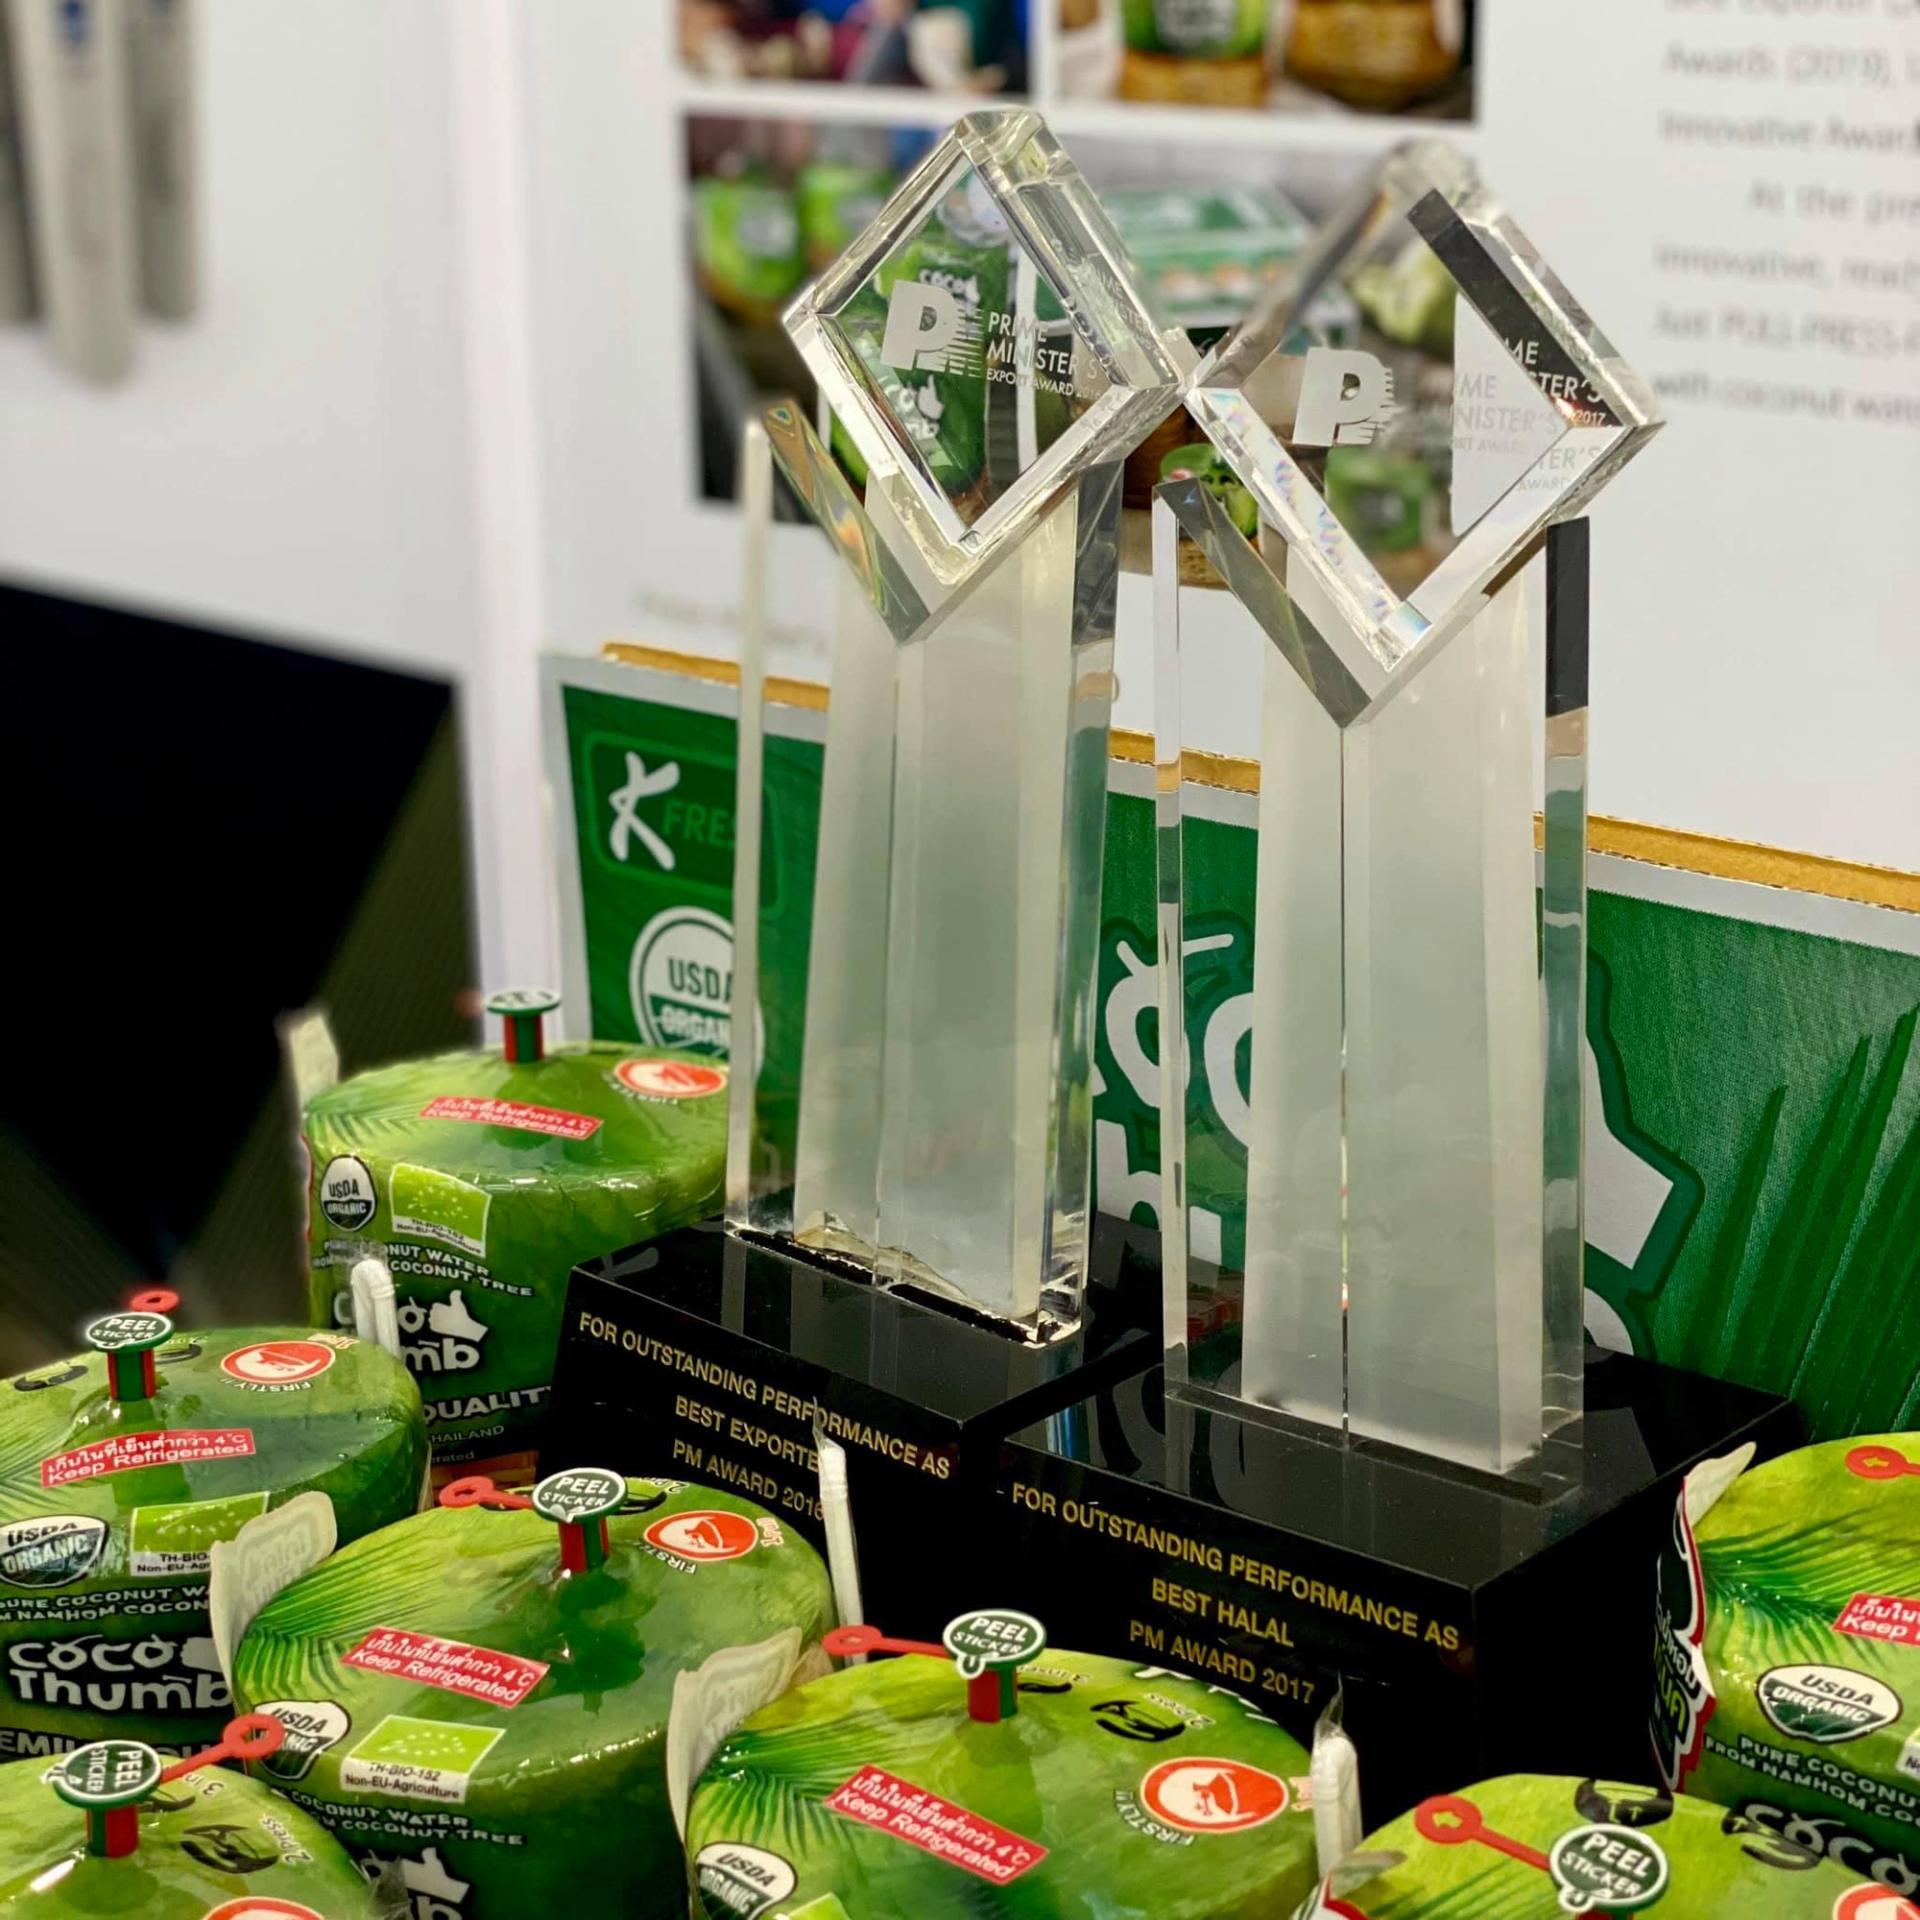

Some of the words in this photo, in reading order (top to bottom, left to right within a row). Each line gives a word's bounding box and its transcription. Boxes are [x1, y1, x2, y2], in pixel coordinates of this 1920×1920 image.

[987, 311, 1047, 343] PRIME
[1033, 377, 1075, 397] AWARD
[662, 800, 736, 848] FRE
[328, 1179, 360, 1199] USDA
[326, 1200, 368, 1216] ORGANIC
[390, 1260, 477, 1283] COCONUT
[479, 1276, 534, 1297] TREE
[426, 1247, 490, 1277] WATER
[92, 1329, 155, 1340] STICKER
[105, 1317, 157, 1332] PEEL
[423, 1386, 552, 1421] QUALIT
[579, 1312, 617, 1344] FOR
[622, 1330, 757, 1401] OUTSTANDING
[762, 1385, 919, 1466] PERFORMANCE
[921, 1456, 951, 1480] AS
[430, 1425, 506, 1444] HAILAND
[676, 1395, 725, 1432] BEST
[730, 1417, 820, 1474] EXPORTE
[48, 1460, 105, 1484] Keep
[113, 1443, 249, 1467] Refrigerated
[673, 1439, 702, 1470] PM
[706, 1453, 778, 1500] AWARD
[540, 1491, 607, 1506] STICKER
[555, 1476, 611, 1495] PEEL
[7, 1521, 78, 1547] USDA
[4, 1534, 90, 1574] ORGANIC
[160, 1551, 210, 1563] TH-BIO-
[1012, 1482, 1057, 1517] FOR
[1062, 1501, 1223, 1572] OUTSTANDING
[1229, 1553, 1418, 1638] PERFORMANCE
[1424, 1620, 1460, 1650] AS
[16, 1606, 117, 1622] NAMHOM
[123, 1599, 210, 1615] COCON
[56, 1588, 174, 1608] COCONUT
[1152, 1577, 1211, 1618] BEST
[1217, 1604, 1295, 1648] HALAL
[952, 1631, 1022, 1654] STICKER
[969, 1616, 1029, 1642] PEEL
[1842, 1614, 1907, 1640] Keep
[351, 1649, 401, 1670] Keep
[404, 1661, 522, 1701] Refrigerated
[1129, 1620, 1164, 1652] PM
[1170, 1638, 1256, 1684] AWARD
[1261, 1668, 1315, 1704] 2017
[1773, 1686, 1872, 1722] ORGANIC
[1801, 1673, 1874, 1706] USDA
[270, 1707, 328, 1734] USDA
[86, 1745, 108, 1793] STICKER
[115, 1749, 144, 1789] PEEL
[1705, 1736, 1756, 1768] FROM
[1762, 1762, 1866, 1810] NAMHOM
[1741, 1737, 1800, 1767] PURE
[1807, 1757, 1920, 1808] COCONU
[291, 1790, 380, 1818] COCONUT
[387, 1808, 469, 1827] WATER
[341, 1820, 447, 1839] COCONUT
[457, 1829, 523, 1845] TREE
[832, 1789, 888, 1821] Keep
[889, 1813, 1016, 1879] Refrigerated
[716, 1852, 776, 1888] USDA
[1582, 1832, 1652, 1878] PEEL
[1561, 1852, 1641, 1897] STICKER
